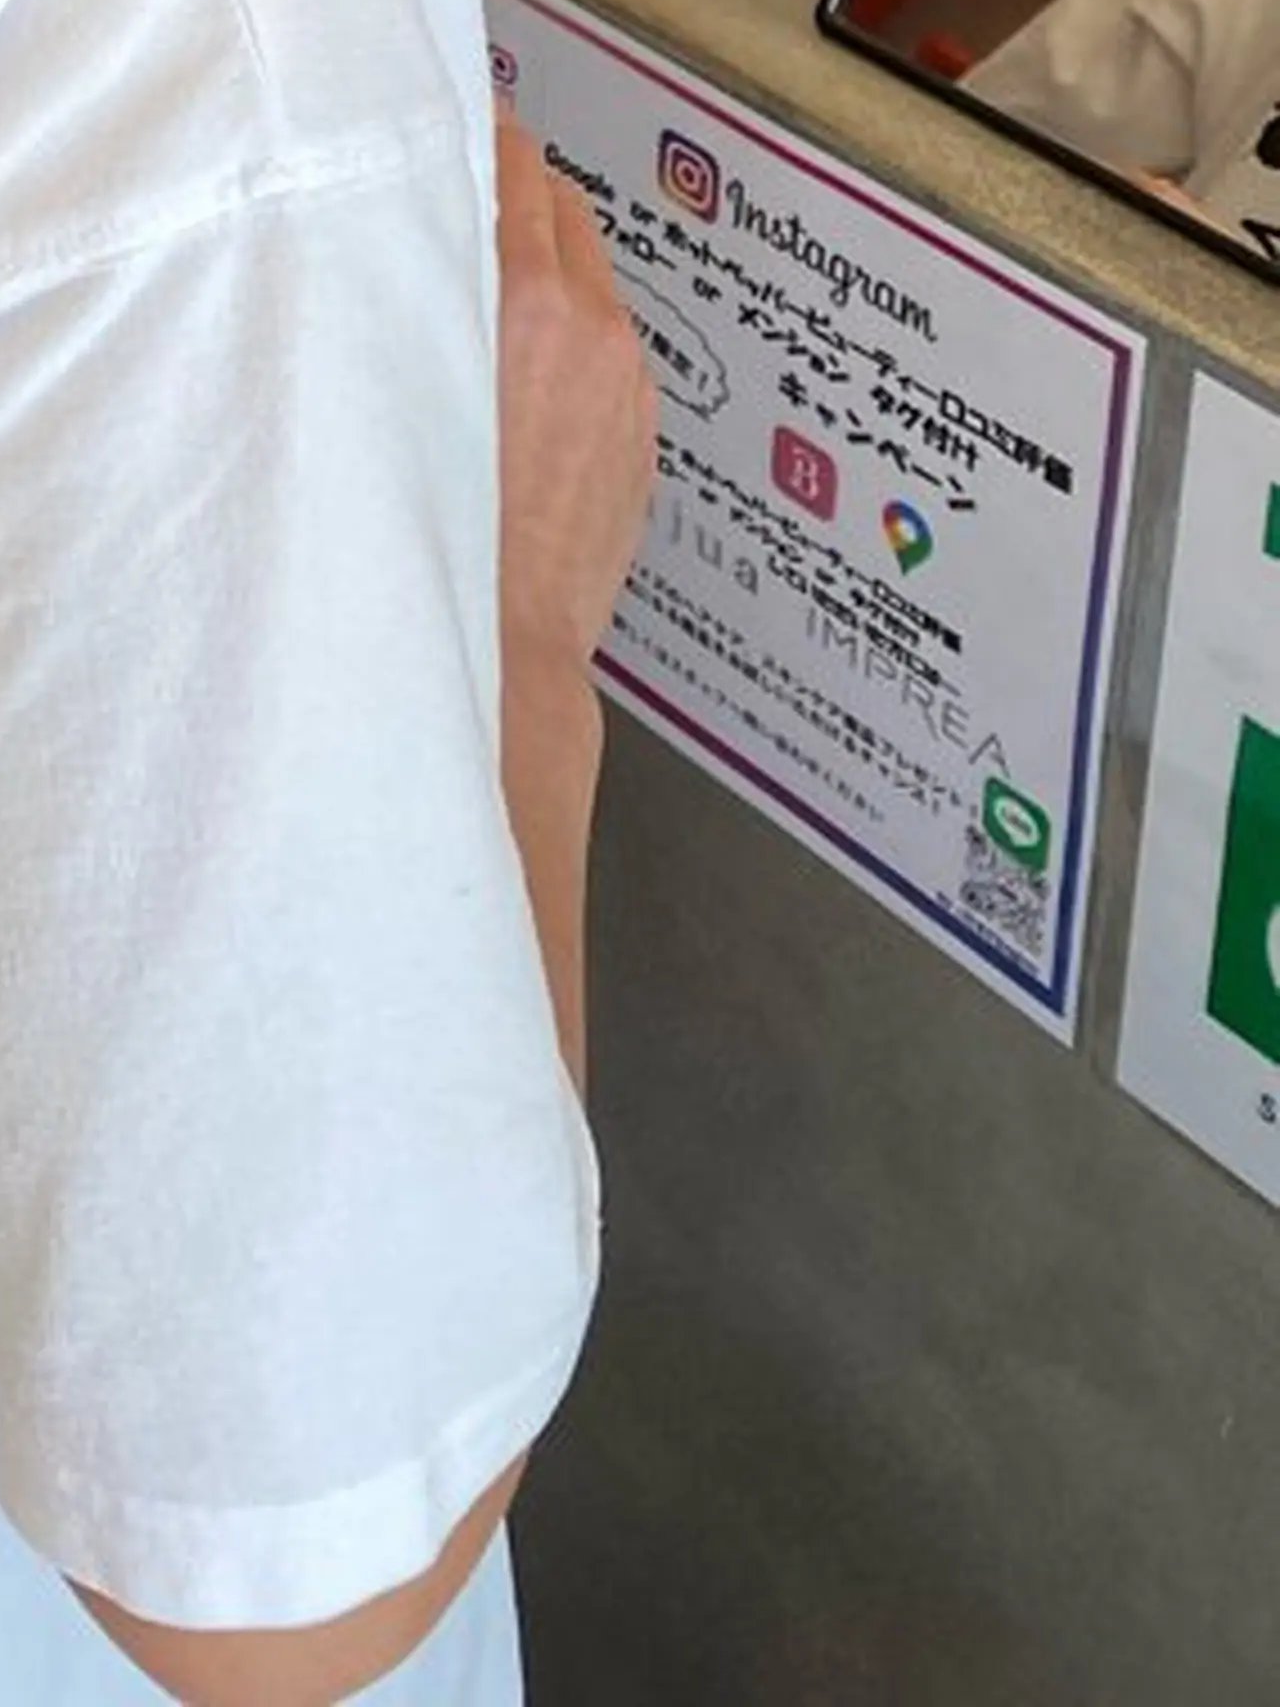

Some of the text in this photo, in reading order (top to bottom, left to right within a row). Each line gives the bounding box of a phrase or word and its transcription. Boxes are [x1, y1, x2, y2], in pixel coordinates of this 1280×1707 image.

[630, 202, 658, 225] or
[725, 177, 938, 343] Instagram
[595, 206, 981, 474] フォロー or メンション タグ付け
[778, 370, 978, 513] キャンペーン
[646, 492, 1012, 779] jua IMPREA
